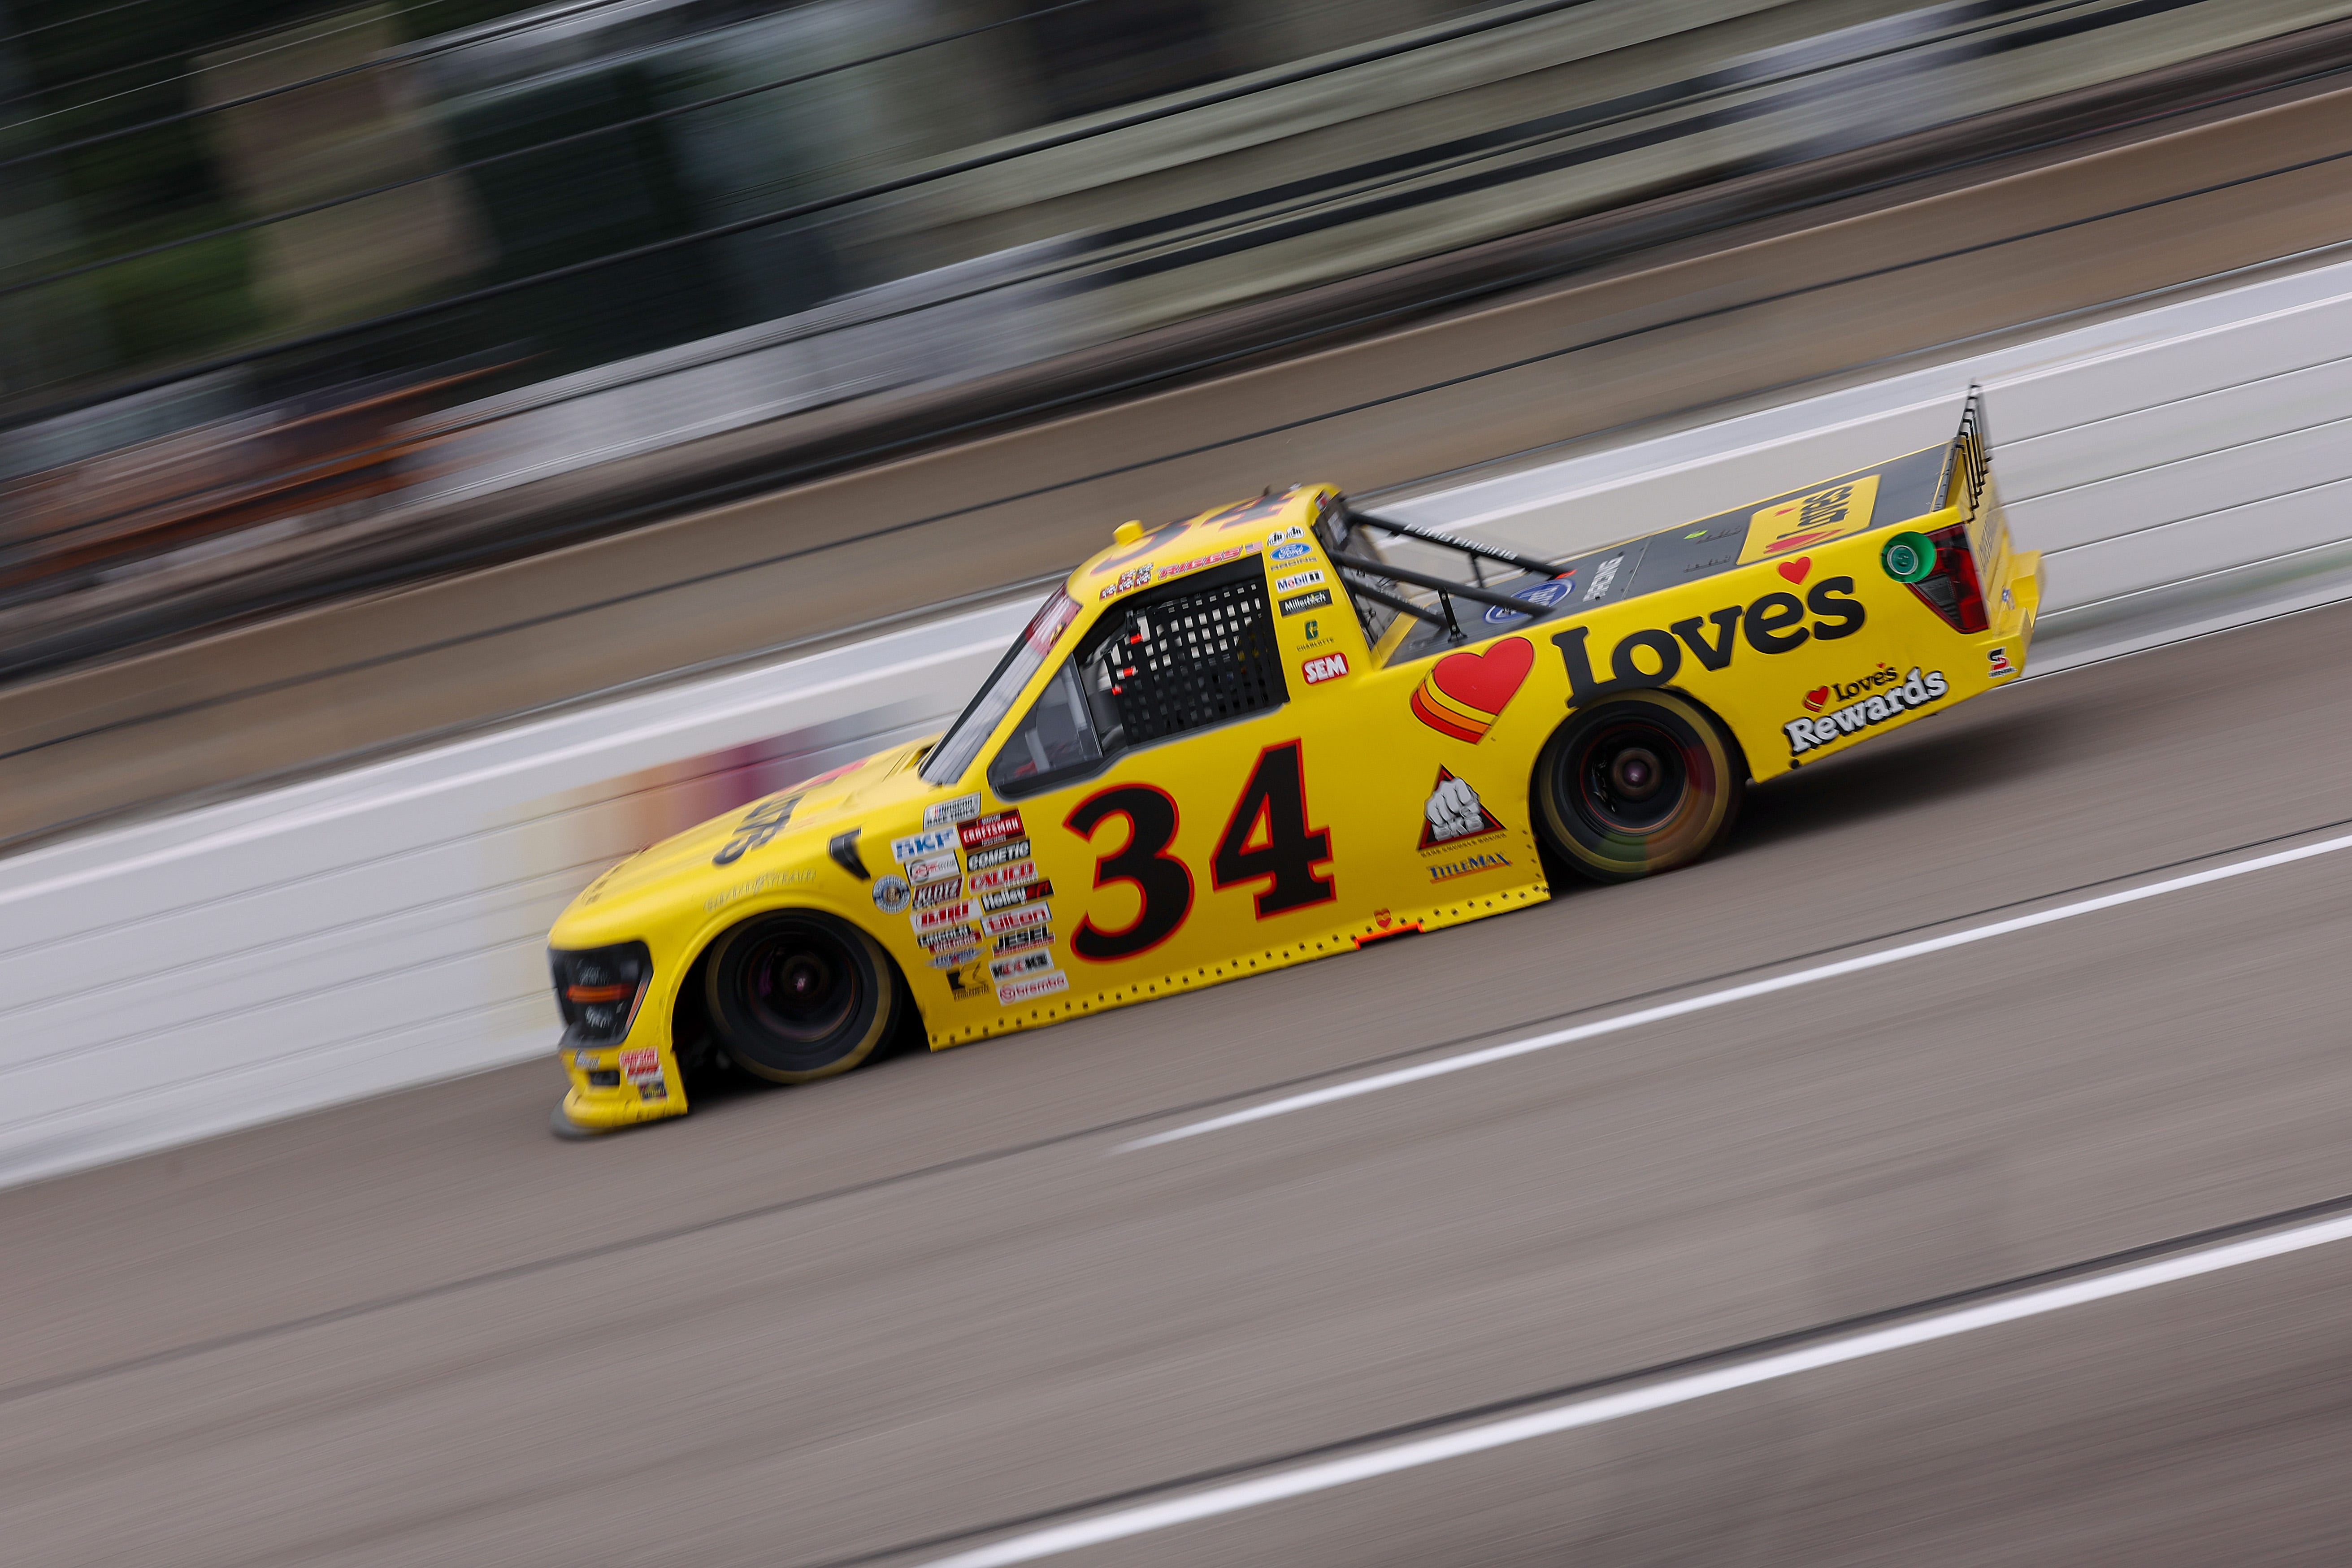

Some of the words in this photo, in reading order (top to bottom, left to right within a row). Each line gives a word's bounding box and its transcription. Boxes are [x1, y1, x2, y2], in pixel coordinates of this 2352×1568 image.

[1277, 573, 1308, 592] Mobil
[1304, 654, 1348, 684] SEM
[1783, 665, 1948, 756] Rewards
[963, 817, 1019, 843] CRAFTSMAN
[968, 840, 1030, 871] COMETIC
[1063, 736, 1337, 965] 34
[982, 886, 1026, 911] Holley
[1016, 975, 1066, 997] brembo
